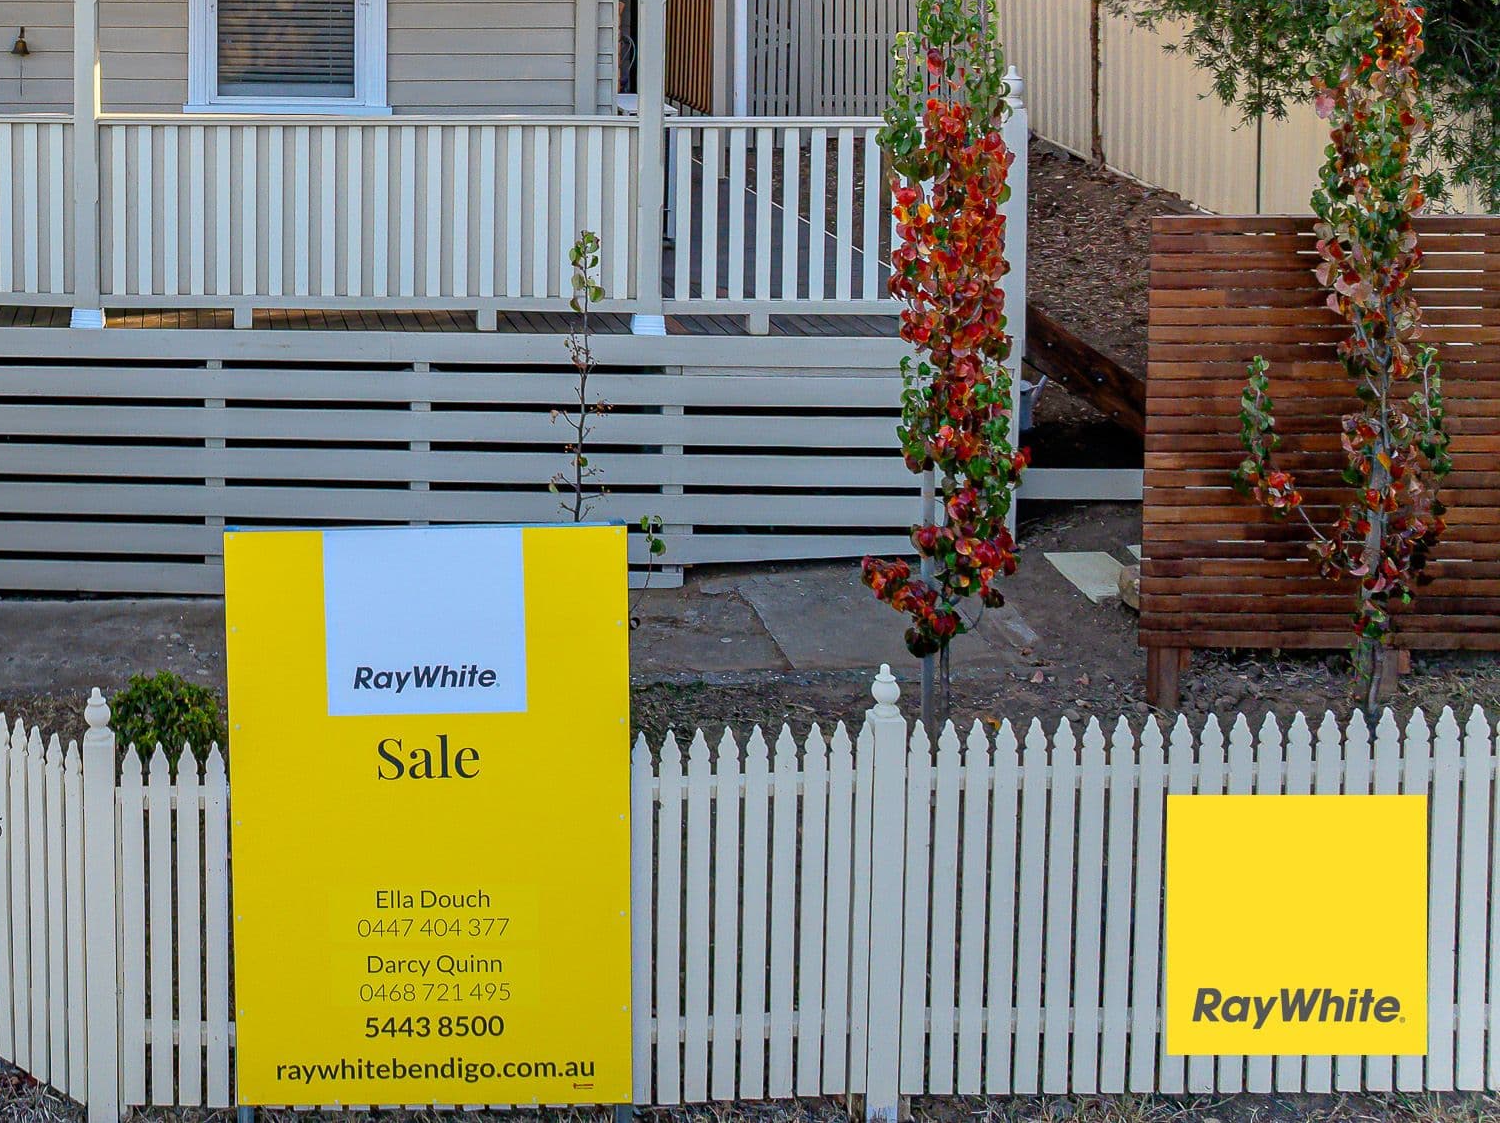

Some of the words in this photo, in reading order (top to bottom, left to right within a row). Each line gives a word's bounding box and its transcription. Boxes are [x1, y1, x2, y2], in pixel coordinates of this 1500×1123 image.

[377, 734, 481, 781] Sale
[376, 889, 414, 909] Ella
[420, 889, 491, 909] Douch
[357, 918, 414, 938] 0447
[419, 918, 463, 938] 404
[467, 917, 510, 937] 377
[366, 955, 431, 978] Darcy
[436, 954, 503, 975] Quinn
[359, 983, 417, 1003] 0468
[422, 983, 464, 1002] 721
[468, 982, 512, 1002] 495
[364, 1016, 431, 1038] 5443
[437, 1015, 505, 1037] 8500
[276, 1057, 595, 1084] raywhitebendigo.com.au
